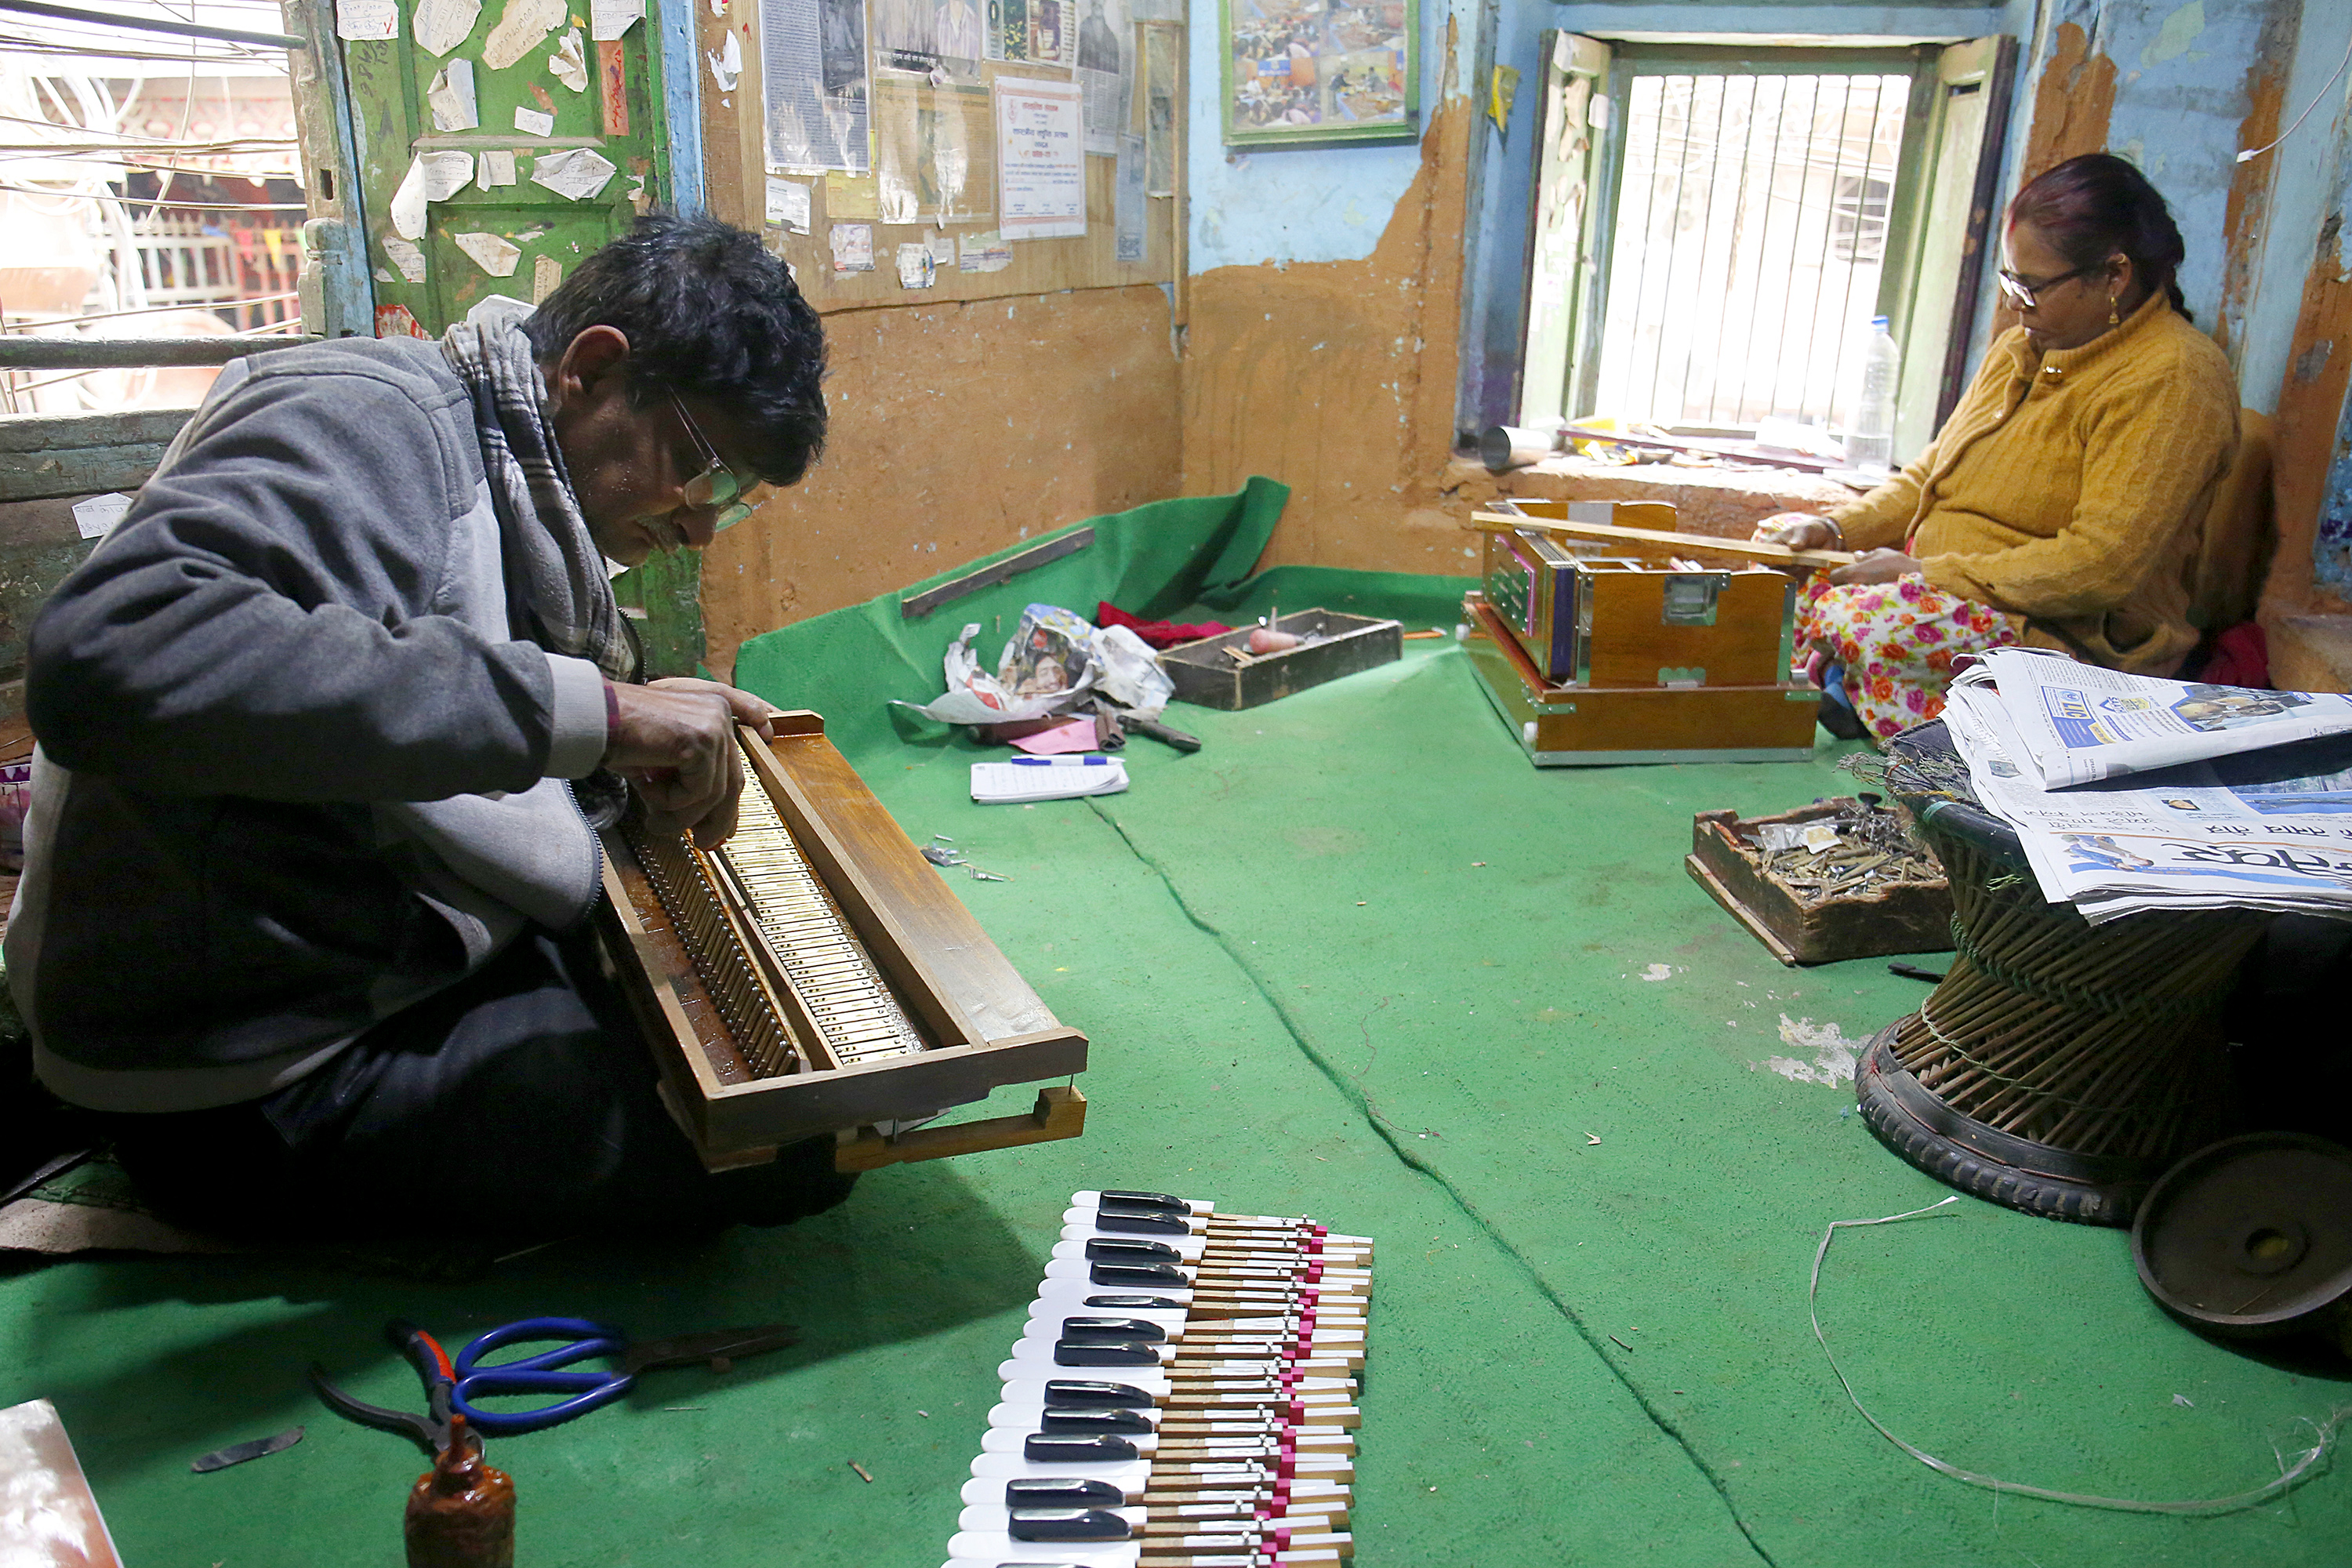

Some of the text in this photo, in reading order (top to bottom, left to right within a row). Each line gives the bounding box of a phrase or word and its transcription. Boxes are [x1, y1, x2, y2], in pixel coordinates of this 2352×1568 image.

[2063, 702, 2087, 717] LIC
[2205, 825, 2254, 836] तीव्र
[2263, 825, 2330, 837] तनाव
